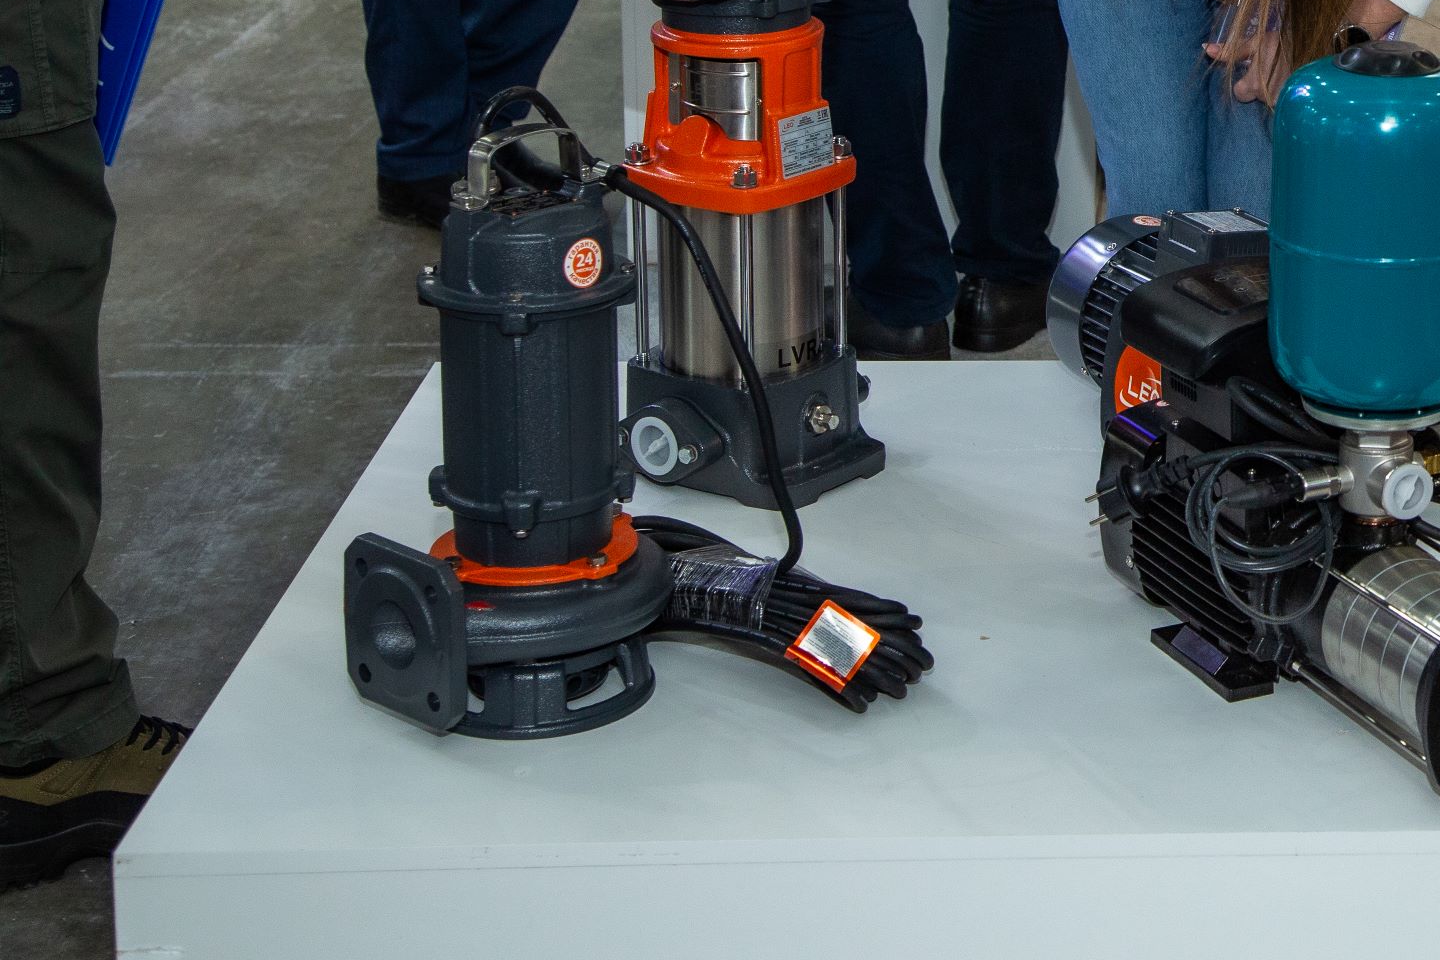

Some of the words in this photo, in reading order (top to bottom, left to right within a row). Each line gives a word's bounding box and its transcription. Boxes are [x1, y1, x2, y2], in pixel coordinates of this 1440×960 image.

[568, 241, 599, 259] гарантия
[576, 251, 593, 268] 24
[569, 268, 599, 284] качества
